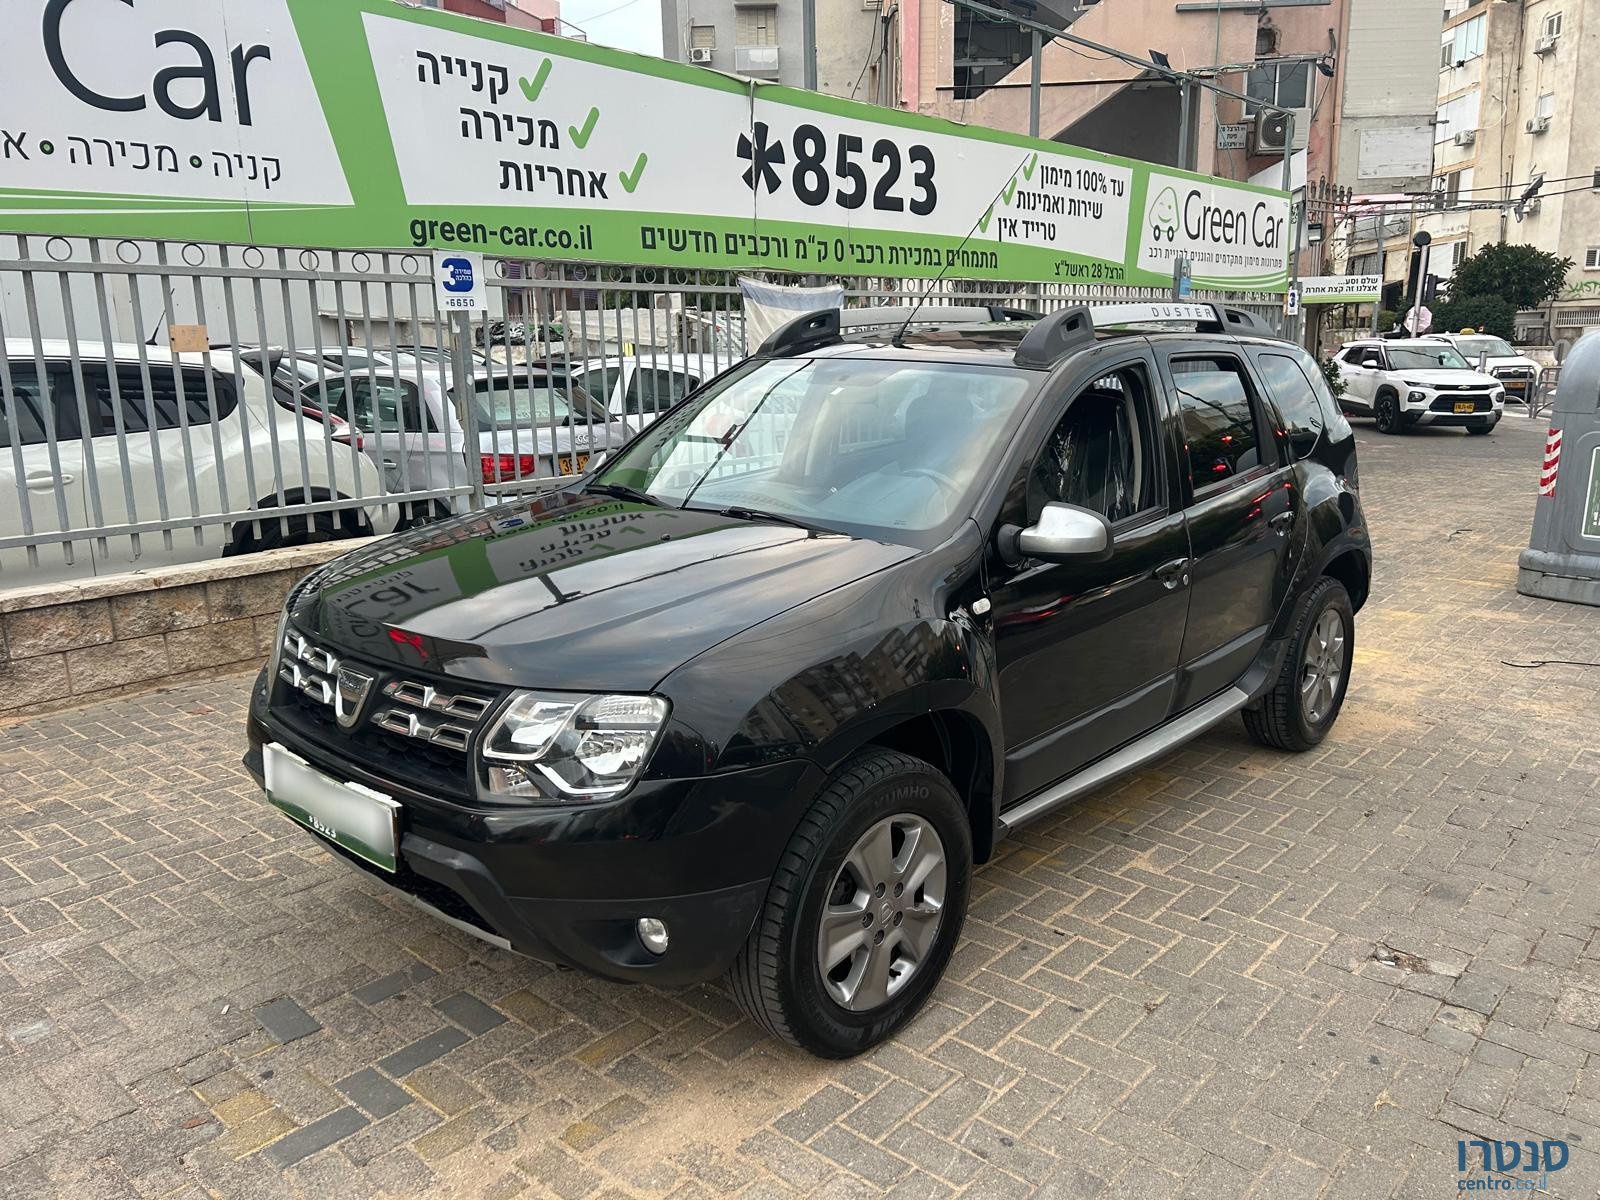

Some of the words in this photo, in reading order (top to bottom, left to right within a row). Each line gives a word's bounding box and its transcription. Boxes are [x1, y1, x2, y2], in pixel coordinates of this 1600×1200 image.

[42, 0, 271, 126] Car
[416, 50, 509, 105] קנייה
[459, 106, 560, 150] מכירה
[67, 135, 180, 173] מכירה
[212, 151, 282, 190] קניה
[499, 160, 609, 200] אחריות
[1040, 164, 1073, 190] מימון
[1076, 169, 1107, 194] 100%
[1110, 178, 1125, 197] עד
[1016, 189, 1065, 216] ואמינות
[1067, 198, 1103, 220] שירות
[997, 216, 1018, 242] אין
[1020, 220, 1057, 241] טרייד
[1184, 189, 1246, 246] Green
[1250, 201, 1284, 249] Car
[409, 218, 593, 251] green-car.co.il
[640, 226, 717, 253] חדשים
[725, 233, 788, 259] ורכבים
[834, 238, 845, 263] 0
[849, 242, 885, 264] רכבי
[888, 245, 942, 268] במכירת
[946, 249, 998, 269] מתמחים
[1091, 262, 1103, 278] 28
[1104, 262, 1125, 280] הרצל
[1151, 306, 1213, 318] DUSTER
